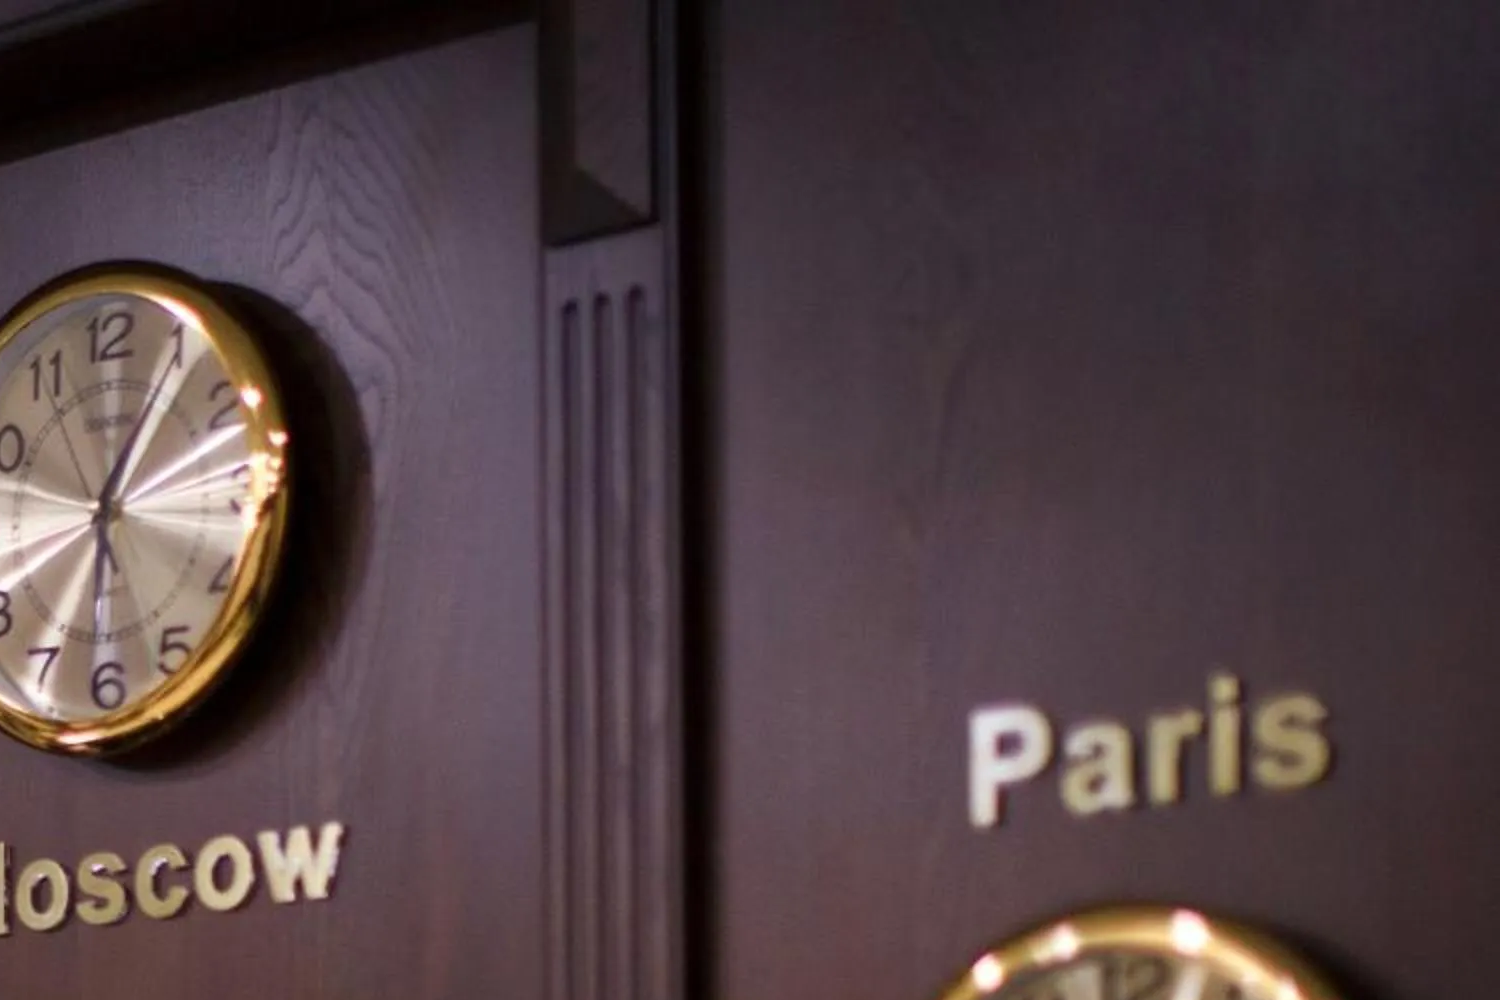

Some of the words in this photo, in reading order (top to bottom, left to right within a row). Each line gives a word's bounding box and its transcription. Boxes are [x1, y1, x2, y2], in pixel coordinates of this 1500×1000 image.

[87, 312, 136, 365] 12
[29, 350, 62, 401] 11
[208, 380, 238, 427] 2
[27, 647, 60, 693] 7
[158, 626, 193, 676] 5
[91, 662, 127, 711] 6
[967, 671, 1333, 829] Paris
